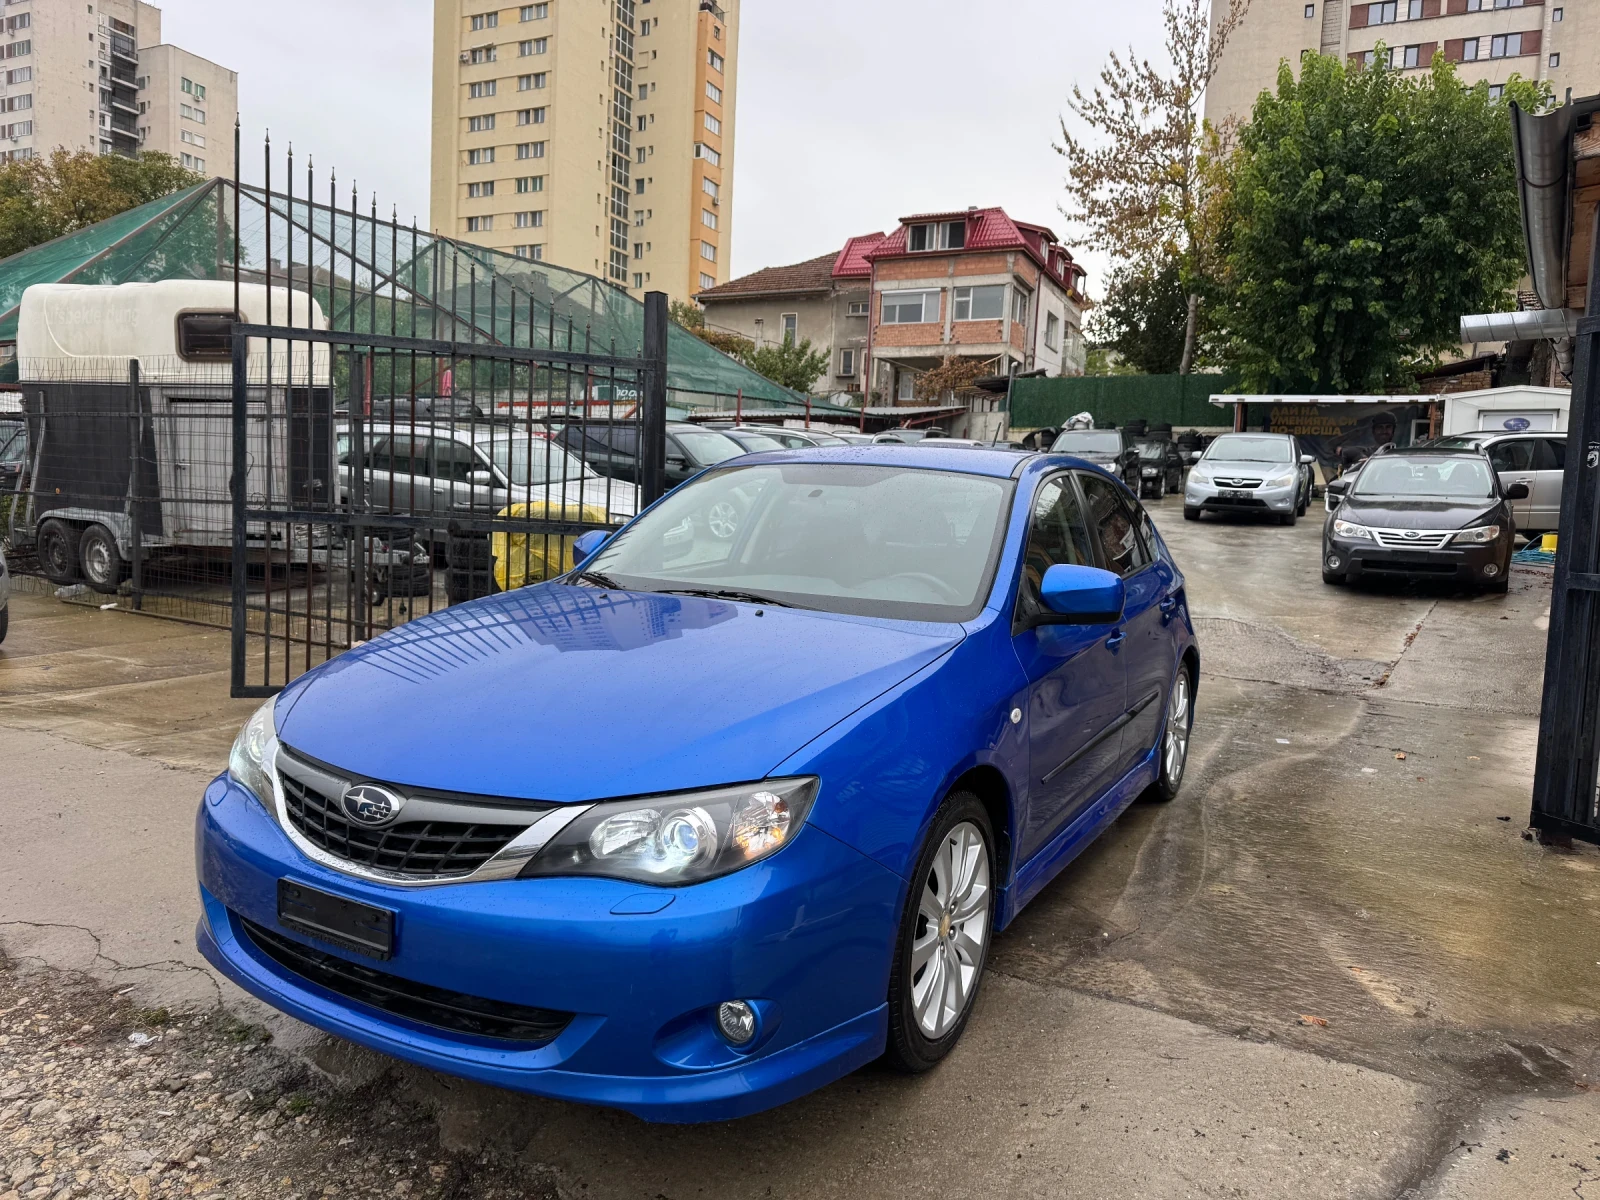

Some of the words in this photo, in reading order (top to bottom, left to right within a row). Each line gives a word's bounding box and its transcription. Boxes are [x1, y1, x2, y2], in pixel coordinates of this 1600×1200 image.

[1301, 406, 1319, 416] НА
[1270, 415, 1337, 426] УМЕНИЯТА
[1339, 416, 1358, 426] СИ
[1269, 425, 1343, 436] ПО-ВИСША
